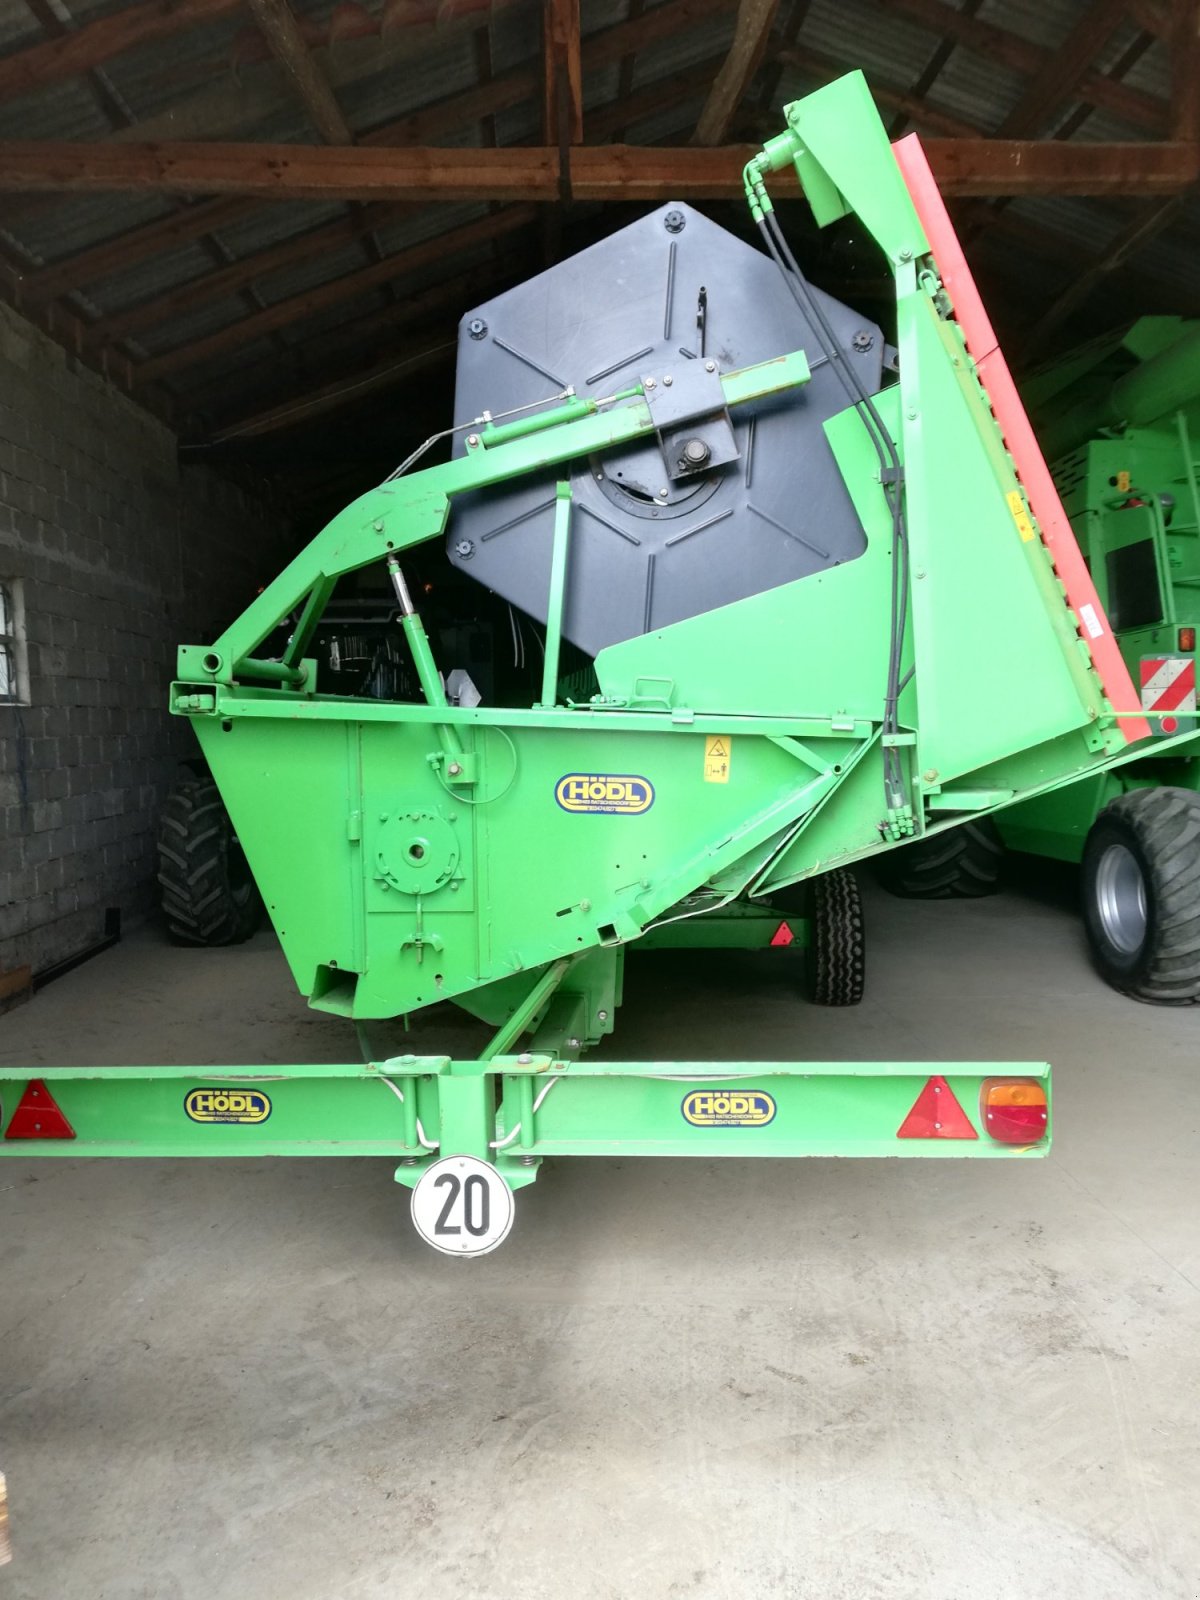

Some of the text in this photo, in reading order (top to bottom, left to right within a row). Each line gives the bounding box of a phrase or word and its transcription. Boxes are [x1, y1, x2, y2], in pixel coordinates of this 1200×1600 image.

[569, 777, 641, 801] HÖDL
[197, 1091, 260, 1112] HÖDL
[695, 1092, 764, 1114] HÖDL
[434, 1173, 490, 1236] 20
